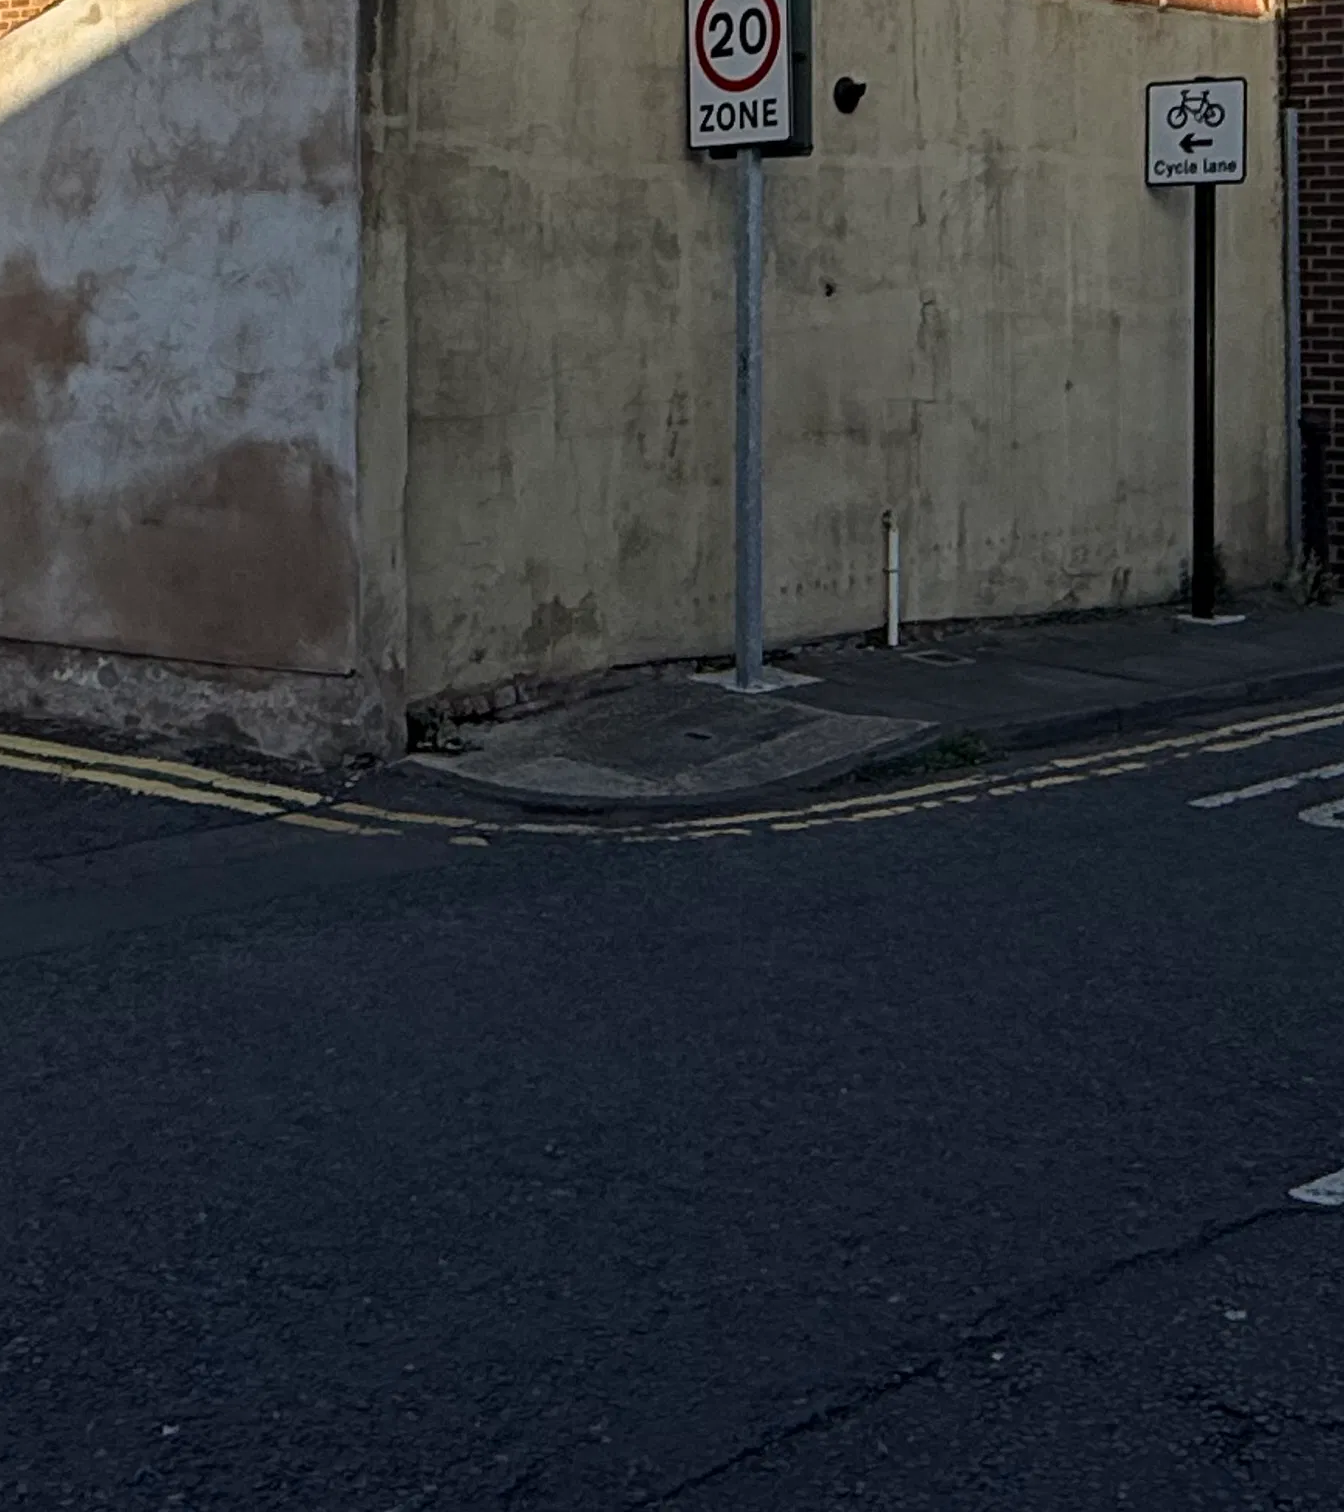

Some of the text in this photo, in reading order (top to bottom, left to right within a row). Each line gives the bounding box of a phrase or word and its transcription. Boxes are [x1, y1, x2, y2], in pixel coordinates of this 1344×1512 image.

[709, 8, 767, 58] 20
[699, 99, 778, 132] ZONE
[1153, 159, 1198, 178] Cycle
